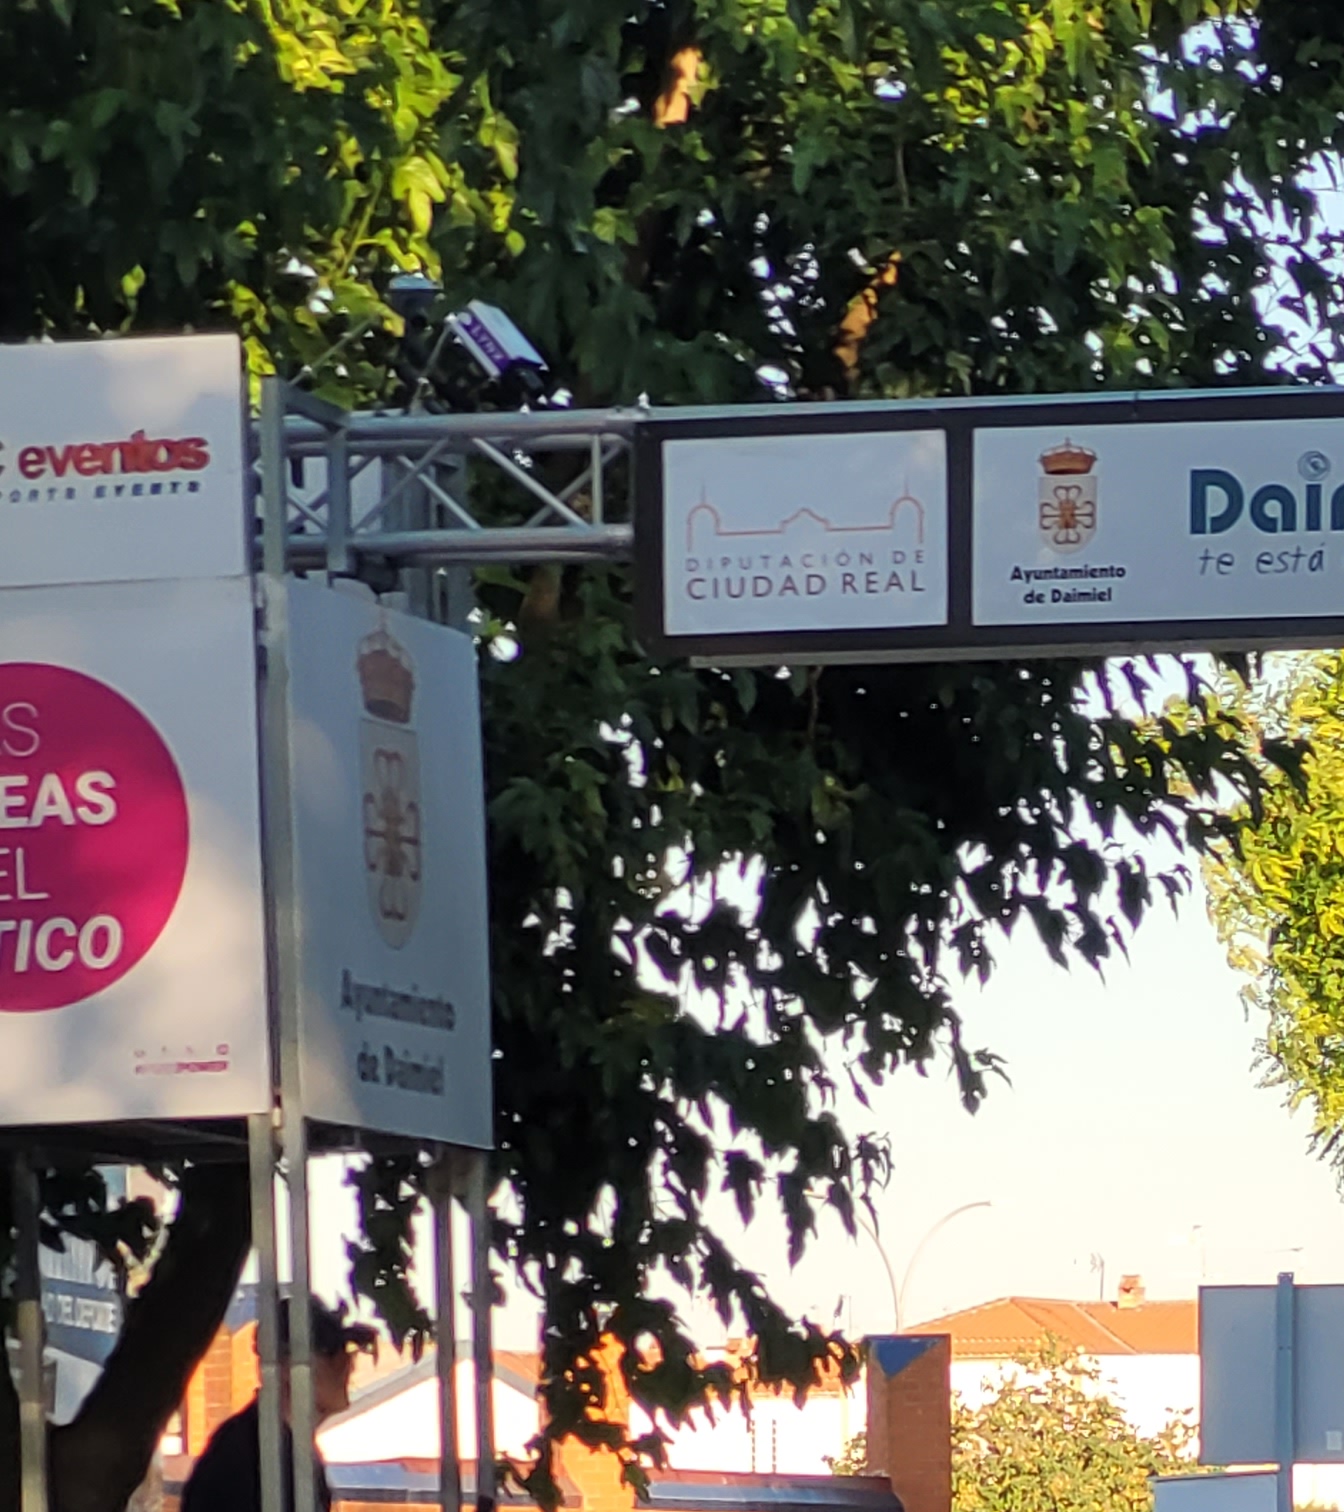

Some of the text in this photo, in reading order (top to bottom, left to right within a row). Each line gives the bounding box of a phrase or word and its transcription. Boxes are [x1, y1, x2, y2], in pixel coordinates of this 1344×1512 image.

[18, 429, 210, 479] eventos
[686, 547, 925, 573] DIPUTACIÓN DE
[1199, 547, 1235, 575] te
[1256, 542, 1325, 574] está
[686, 570, 926, 600] CIUDAD REAL
[1010, 564, 1127, 584] Ayuntamiento
[1023, 586, 1113, 604] de Daimiel
